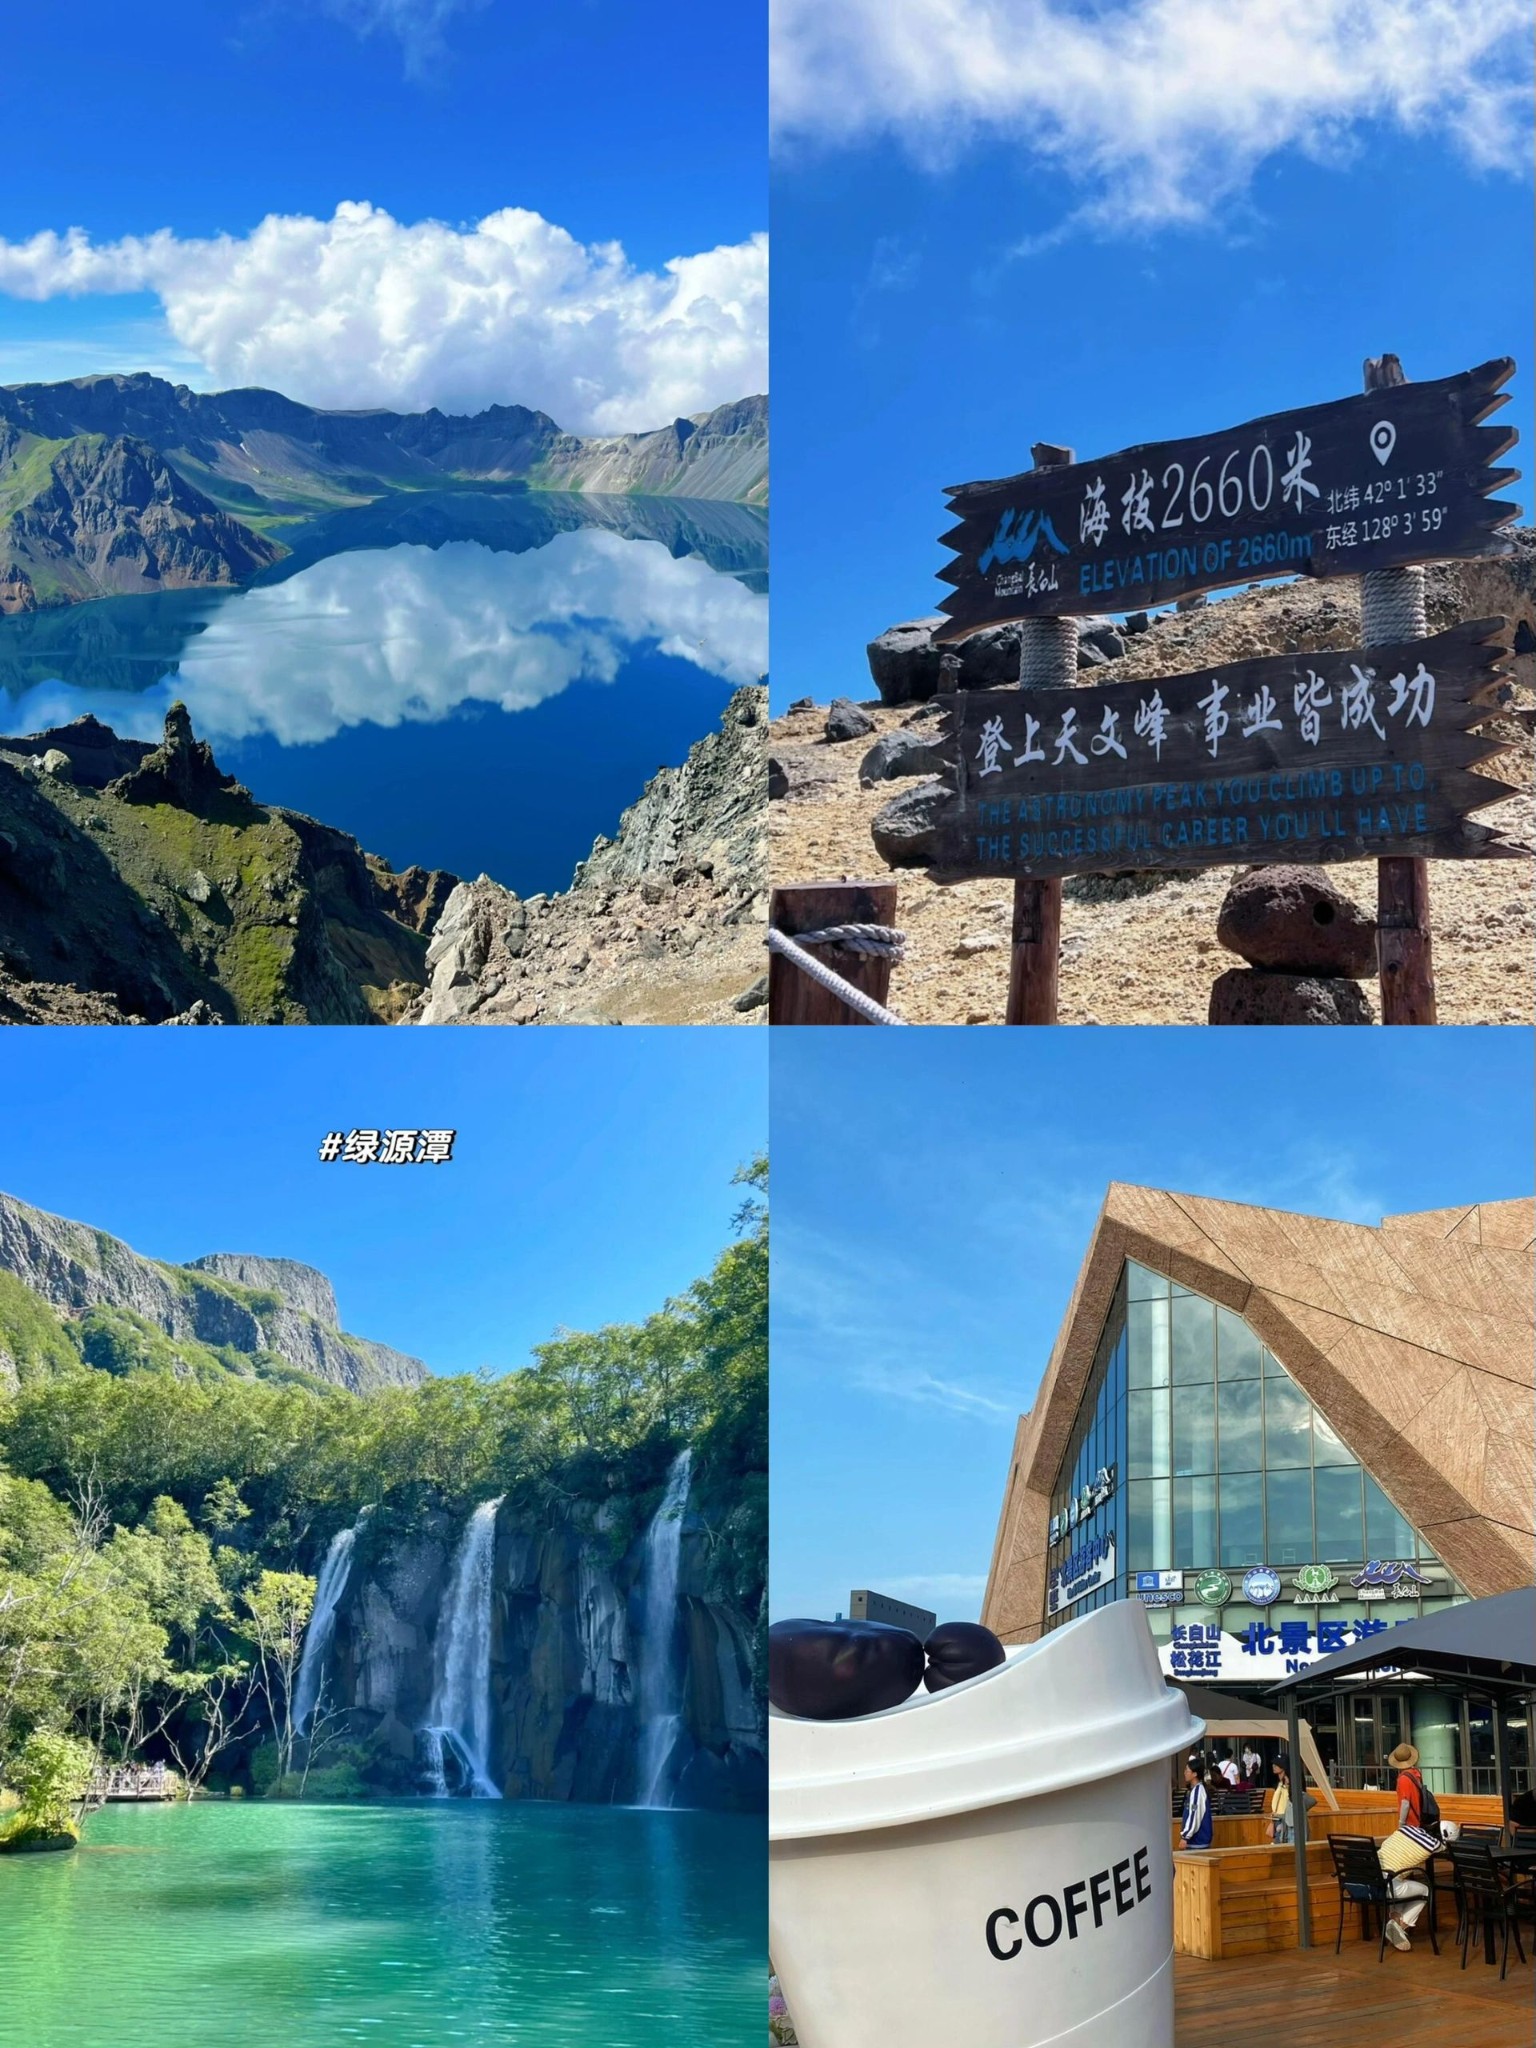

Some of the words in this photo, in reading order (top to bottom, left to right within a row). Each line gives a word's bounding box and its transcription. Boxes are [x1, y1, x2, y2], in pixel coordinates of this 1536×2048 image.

[1079, 431, 1320, 548] 海拔2660米
[1327, 485, 1359, 515] 北纬
[1080, 547, 1197, 596] ELEVATION
[1203, 539, 1232, 573] OF
[1237, 530, 1313, 568] 2660m
[1325, 521, 1358, 550] 东经
[975, 688, 1171, 778] 登上天文峰
[1197, 662, 1437, 758] 事业皆成功
[978, 802, 1011, 825] THE
[1018, 786, 1145, 822] ASTRONOMY
[1152, 783, 1207, 811] PEAK
[1215, 776, 1261, 805] YOU
[1268, 769, 1343, 801] CLIMB
[1352, 766, 1383, 795] UP
[977, 836, 1011, 861] THE
[1020, 823, 1151, 858] SUCCESSFUL
[1162, 816, 1248, 848] CAREER
[1260, 810, 1345, 841] YOU'LL
[1359, 803, 1428, 834] HAVE
[1136, 1592, 1183, 1602] unesco
[1170, 1650, 1222, 1668] 松花江
[1171, 1624, 1221, 1641] 长白山
[985, 1845, 1152, 1961] COFFEE
